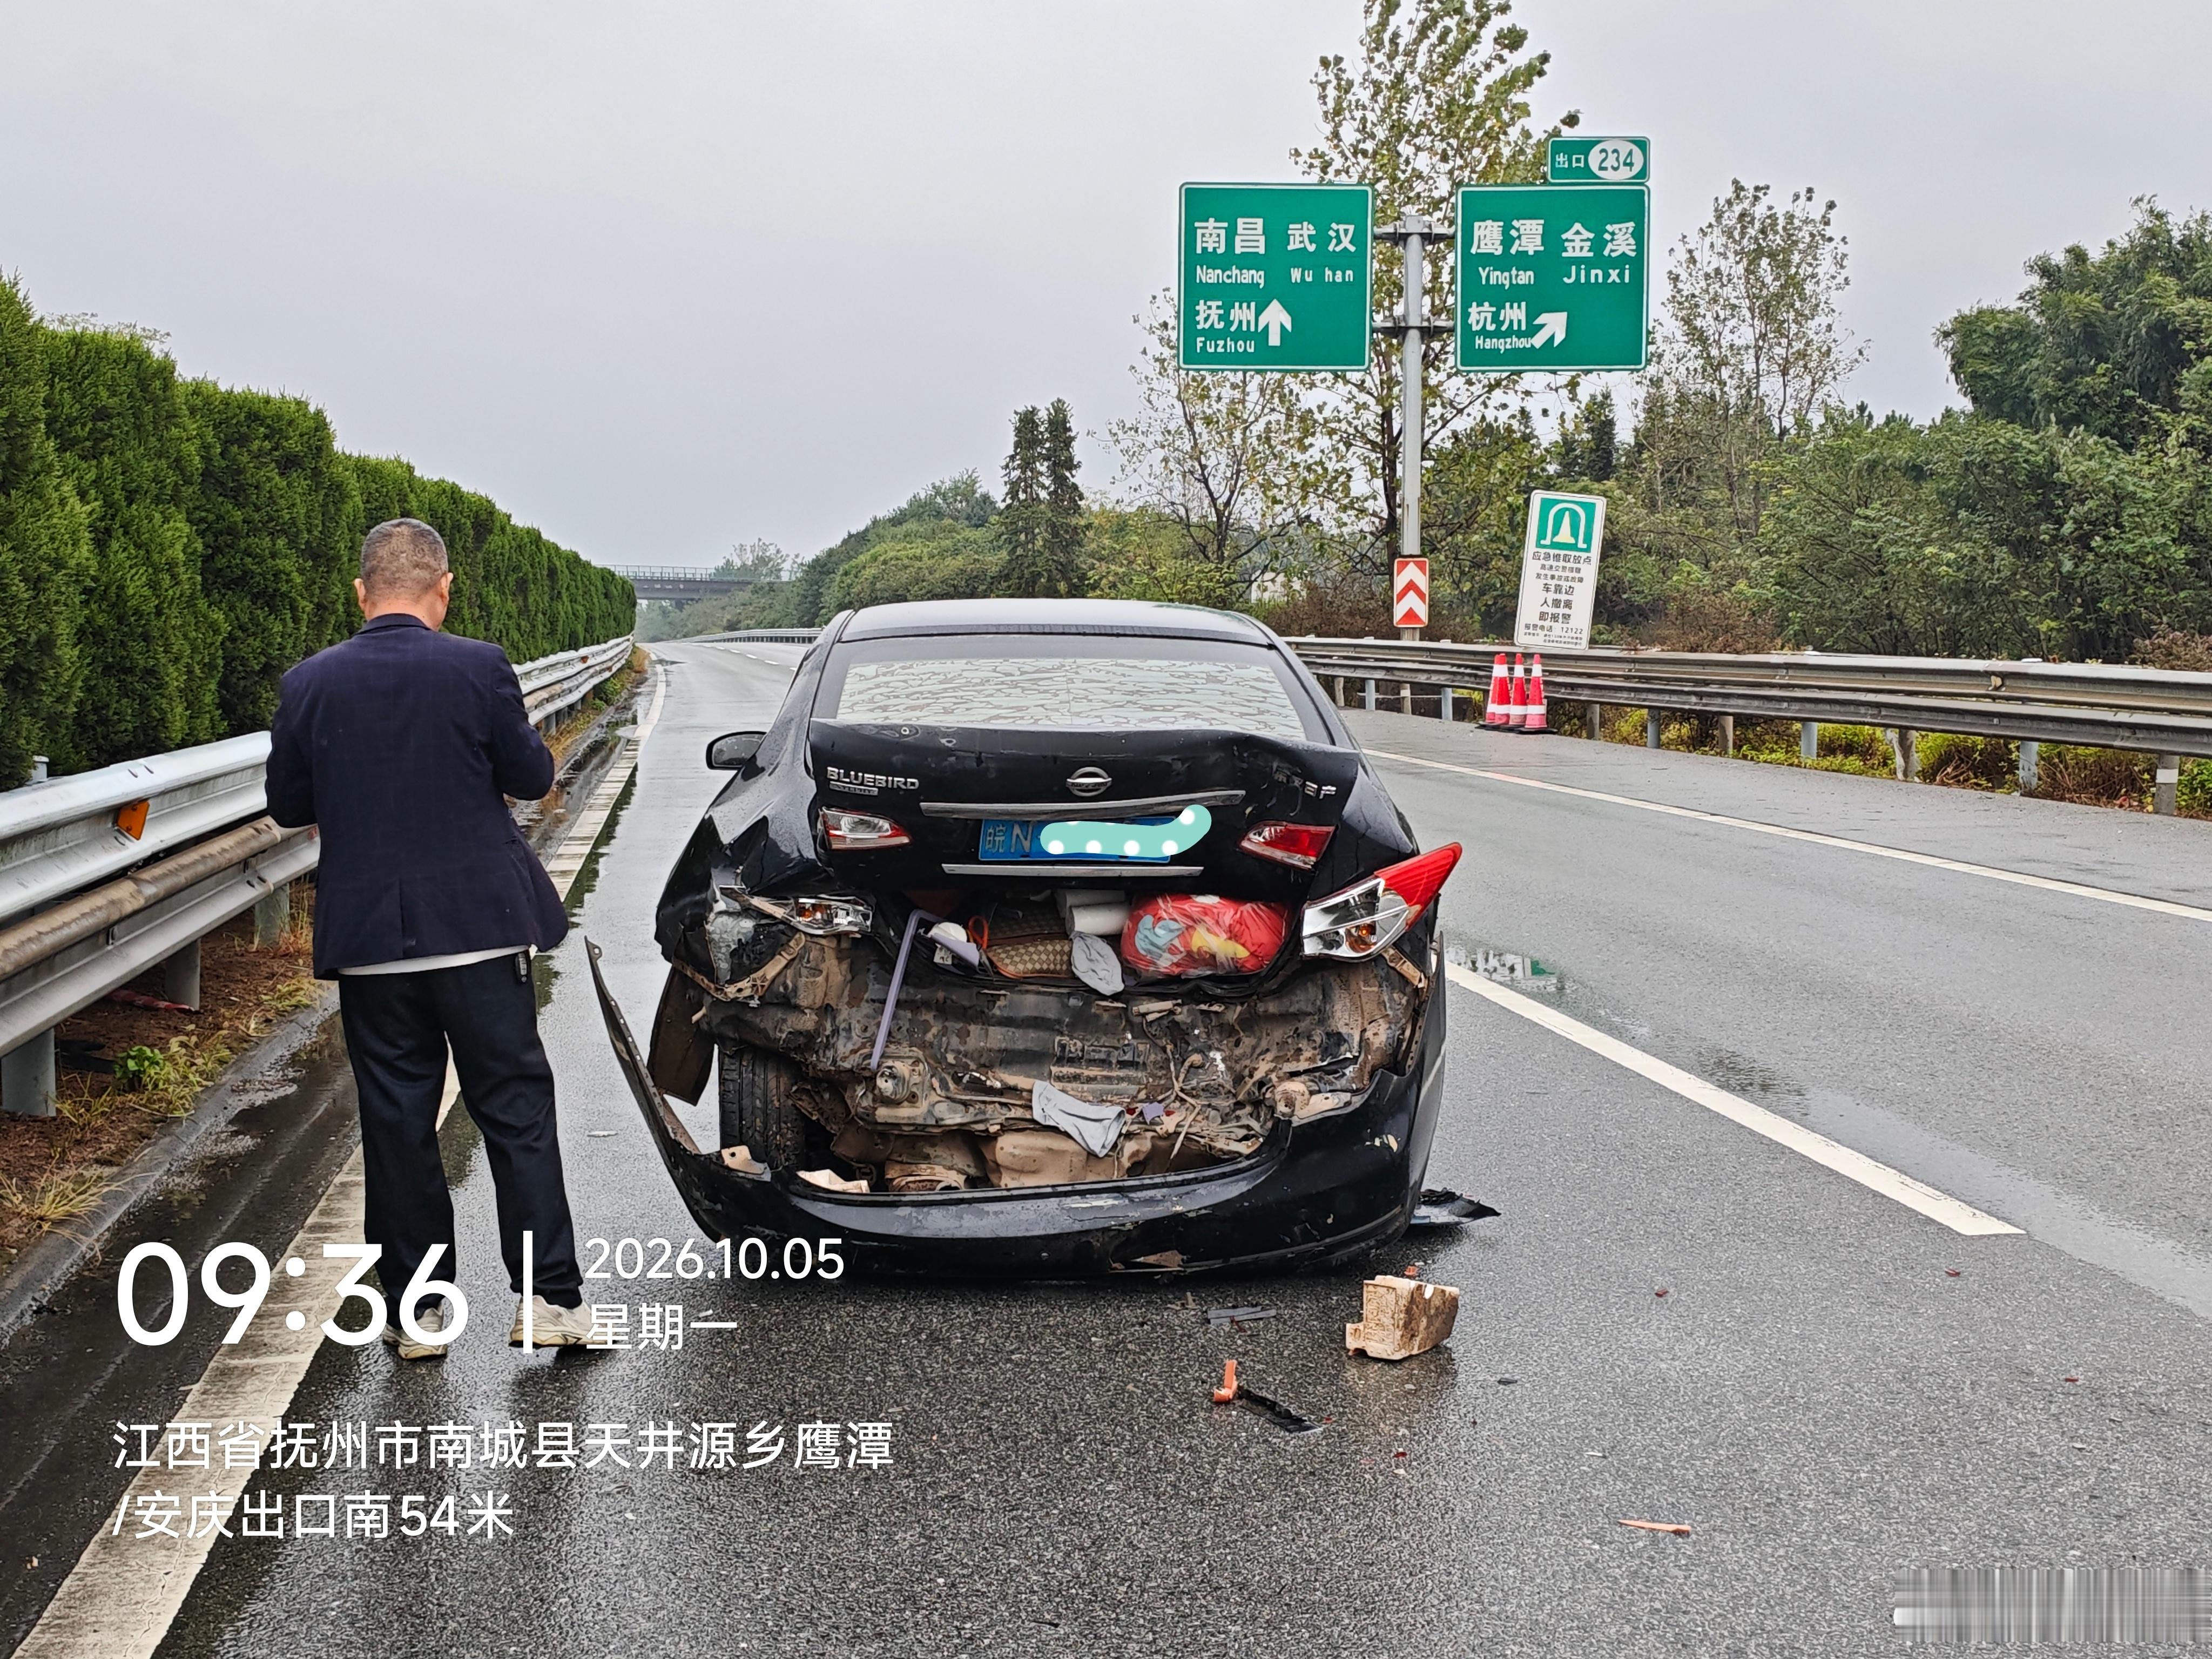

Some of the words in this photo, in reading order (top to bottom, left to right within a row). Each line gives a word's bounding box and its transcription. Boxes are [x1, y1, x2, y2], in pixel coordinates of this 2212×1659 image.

[1555, 153, 1584, 168] 出口
[1597, 148, 1636, 172] 234
[1194, 218, 1266, 254] 南昌
[1287, 221, 1357, 253] 武汉
[1470, 219, 1545, 256] 鹰潭
[1561, 221, 1637, 258] 金溪
[1196, 265, 1265, 288] Nanchang
[1478, 267, 1534, 290] Yingtan
[1563, 265, 1630, 284] Jinxi
[1195, 300, 1256, 332] 抚州
[1467, 301, 1527, 332] 杭州
[1196, 337, 1255, 353] Fuzhou
[1475, 335, 1531, 352] Hangzhou
[1542, 583, 1574, 596] 车靠边
[1540, 597, 1573, 610] 人撤离
[1539, 611, 1571, 624] 即报警
[827, 767, 919, 789] BLUEBIRD
